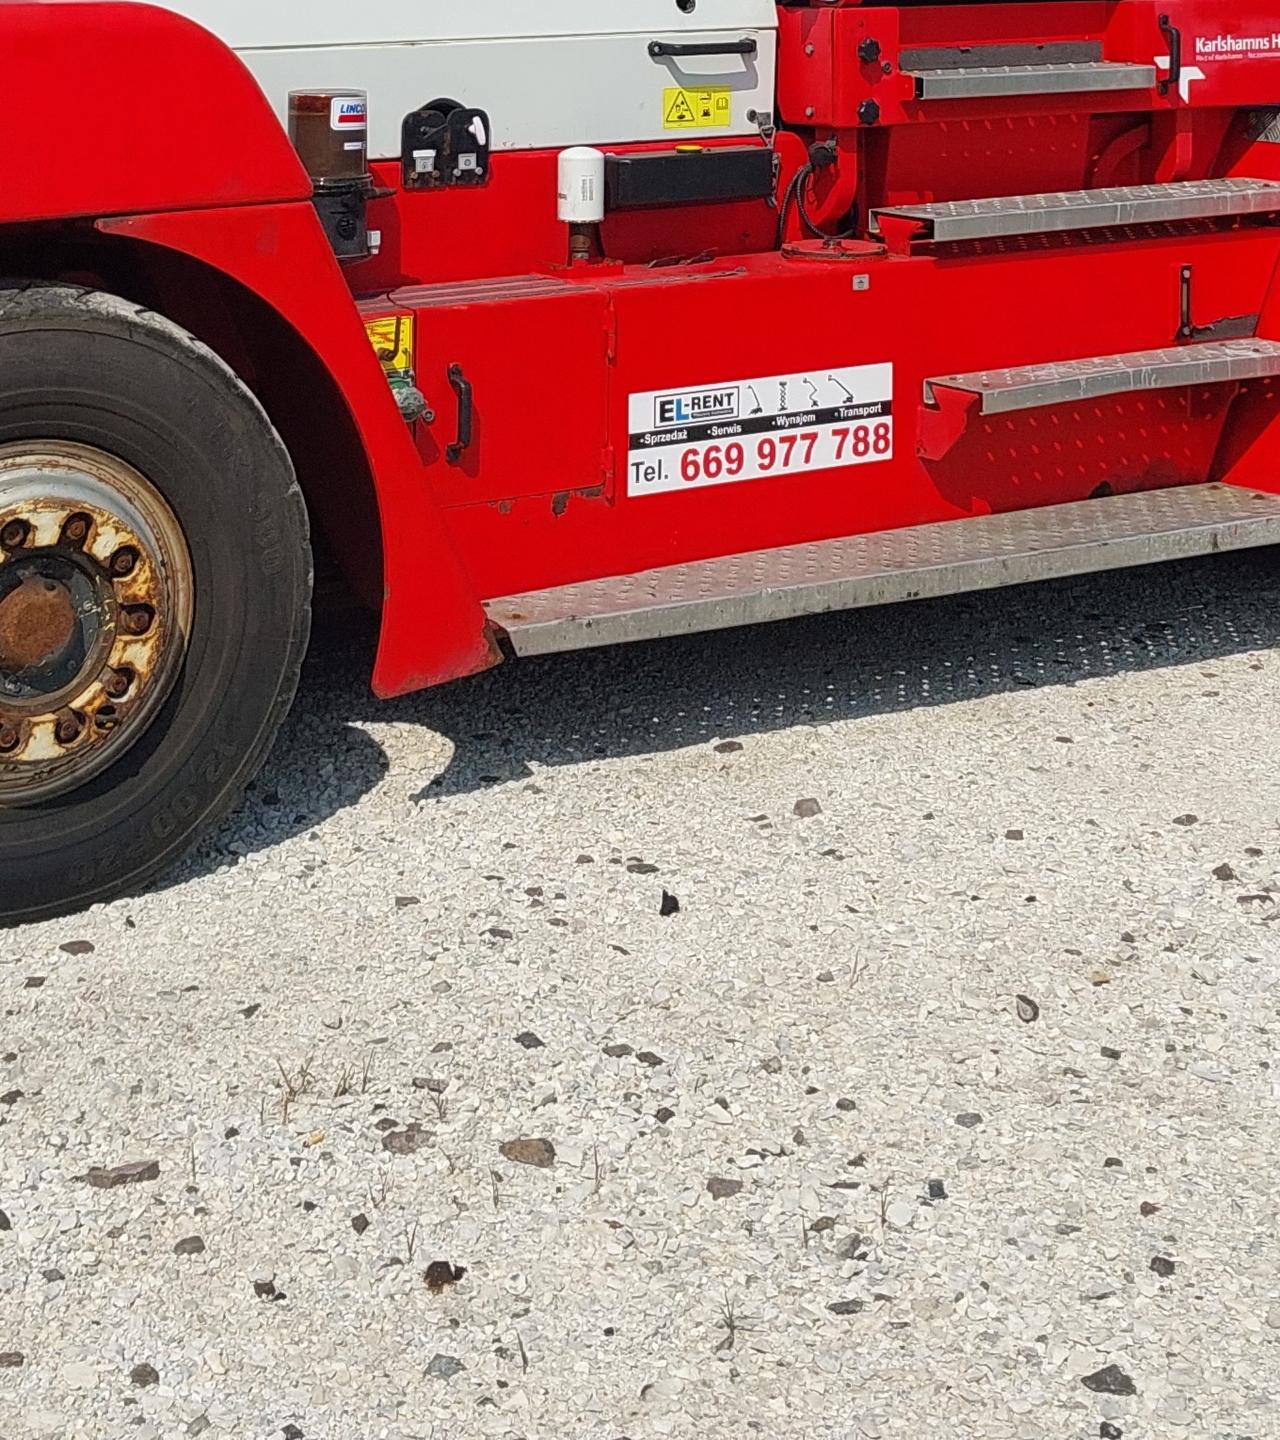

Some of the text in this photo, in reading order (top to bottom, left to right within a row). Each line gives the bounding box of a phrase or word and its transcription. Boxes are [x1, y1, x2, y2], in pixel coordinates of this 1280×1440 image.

[1195, 34, 1269, 53] Karlshamns
[643, 403, 882, 446] Sprzedaż Serwis Wynajem Transport
[659, 392, 735, 423] EL-RENT
[631, 422, 890, 484] Tel. 669 977 788
